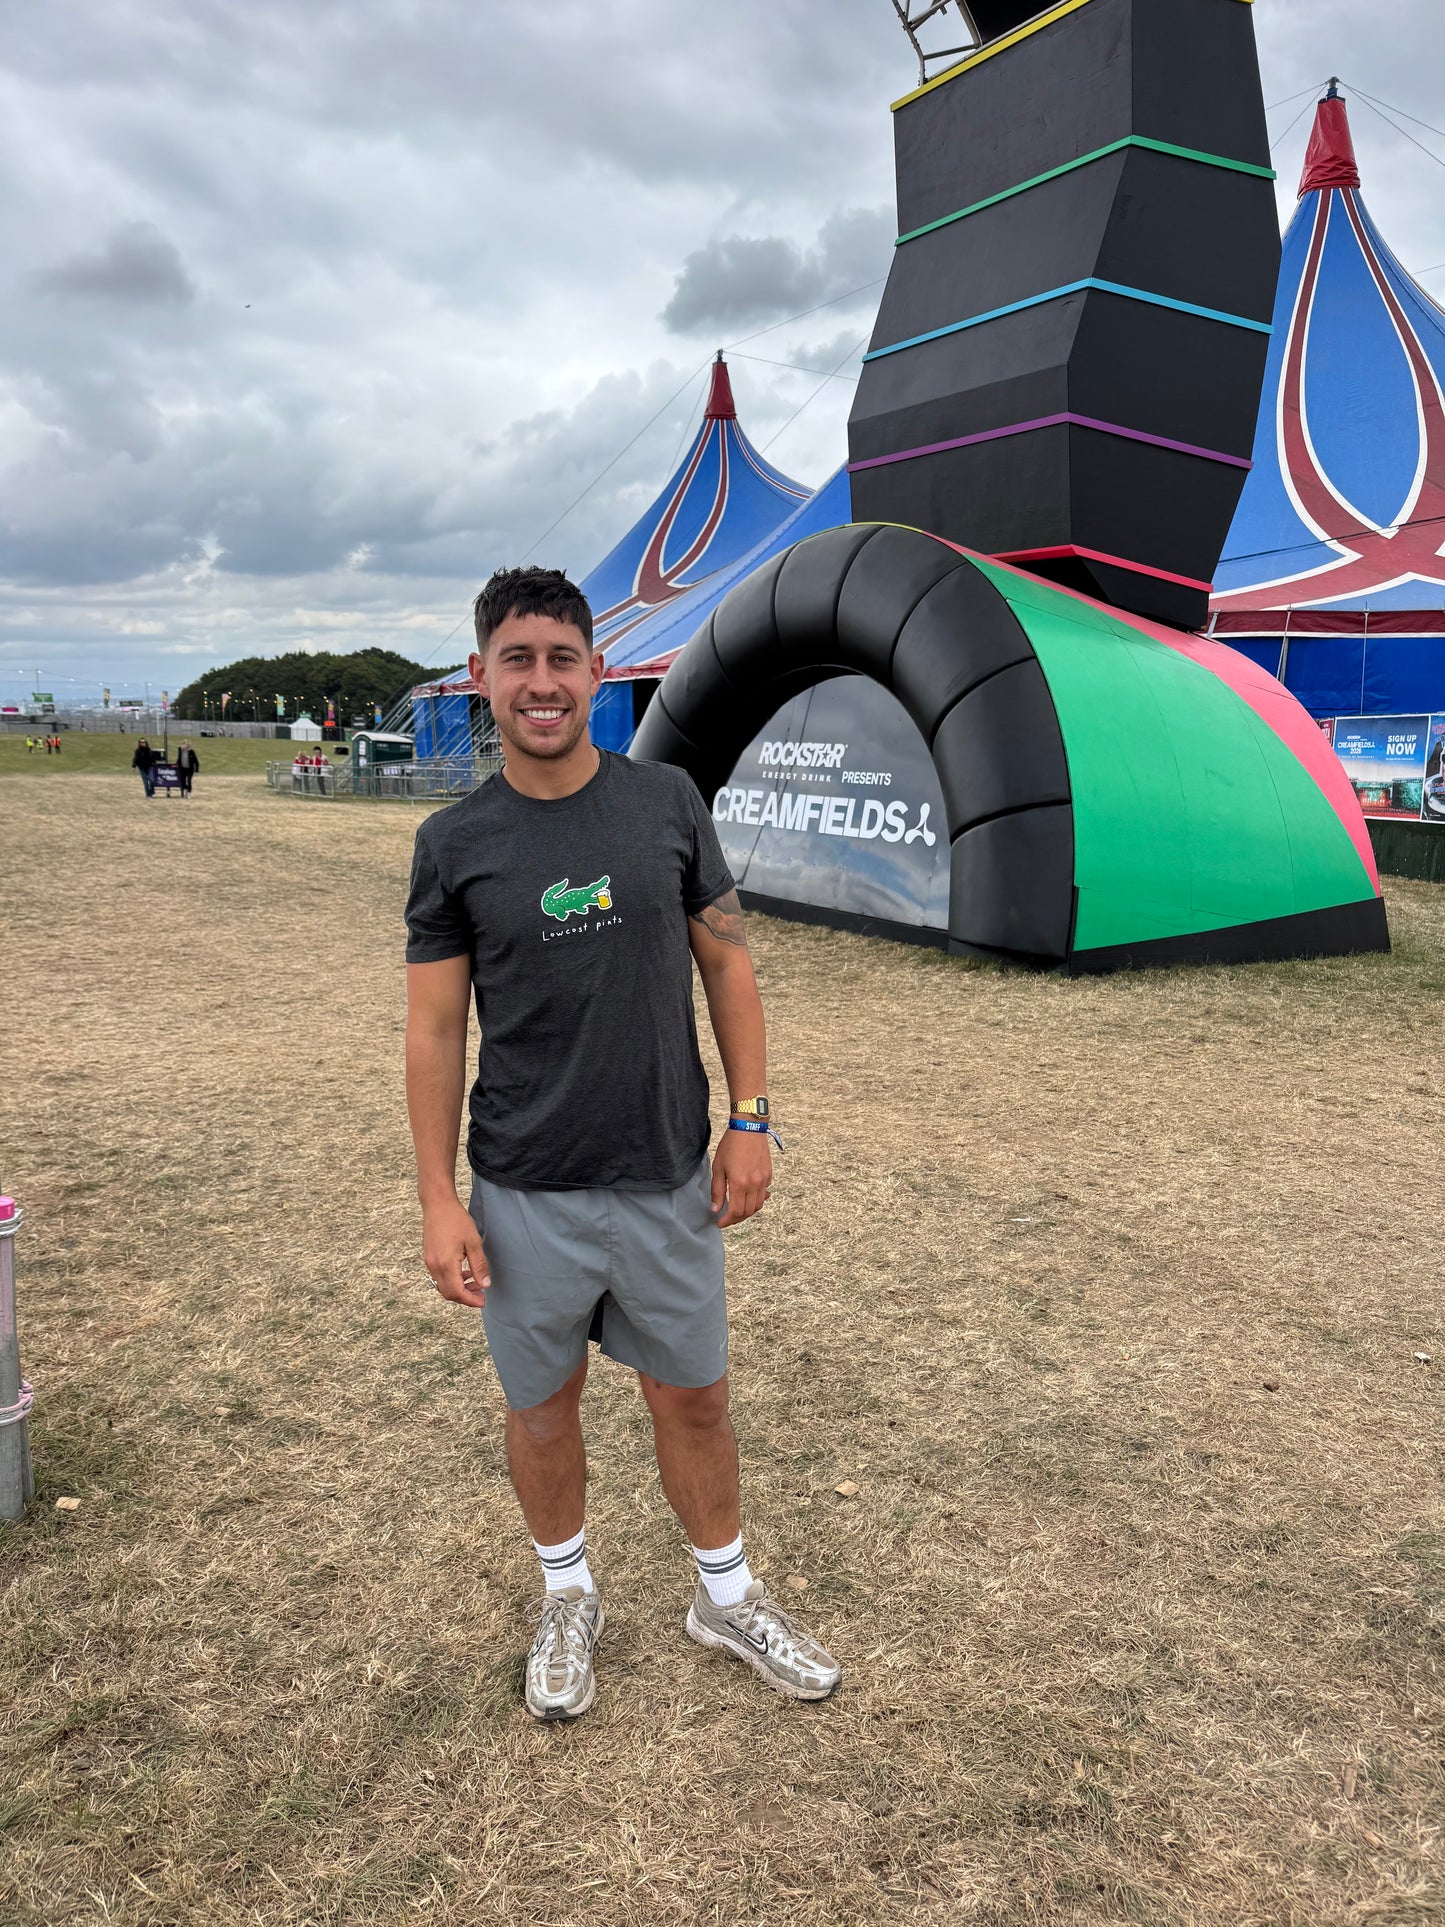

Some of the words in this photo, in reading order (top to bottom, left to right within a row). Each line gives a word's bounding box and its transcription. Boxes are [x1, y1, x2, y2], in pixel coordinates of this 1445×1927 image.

[1406, 734, 1417, 742] UP
[759, 742, 845, 767] ROCKSTAR
[1386, 743, 1416, 755] NOW
[762, 771, 798, 781] ENERGY
[802, 774, 831, 783] DRINK
[842, 771, 892, 786] PRESENTS
[712, 785, 908, 843] CREAMFIELDS
[542, 922, 588, 941] Lowcost
[596, 915, 623, 931] pints
[745, 1122, 760, 1131] STAFF
